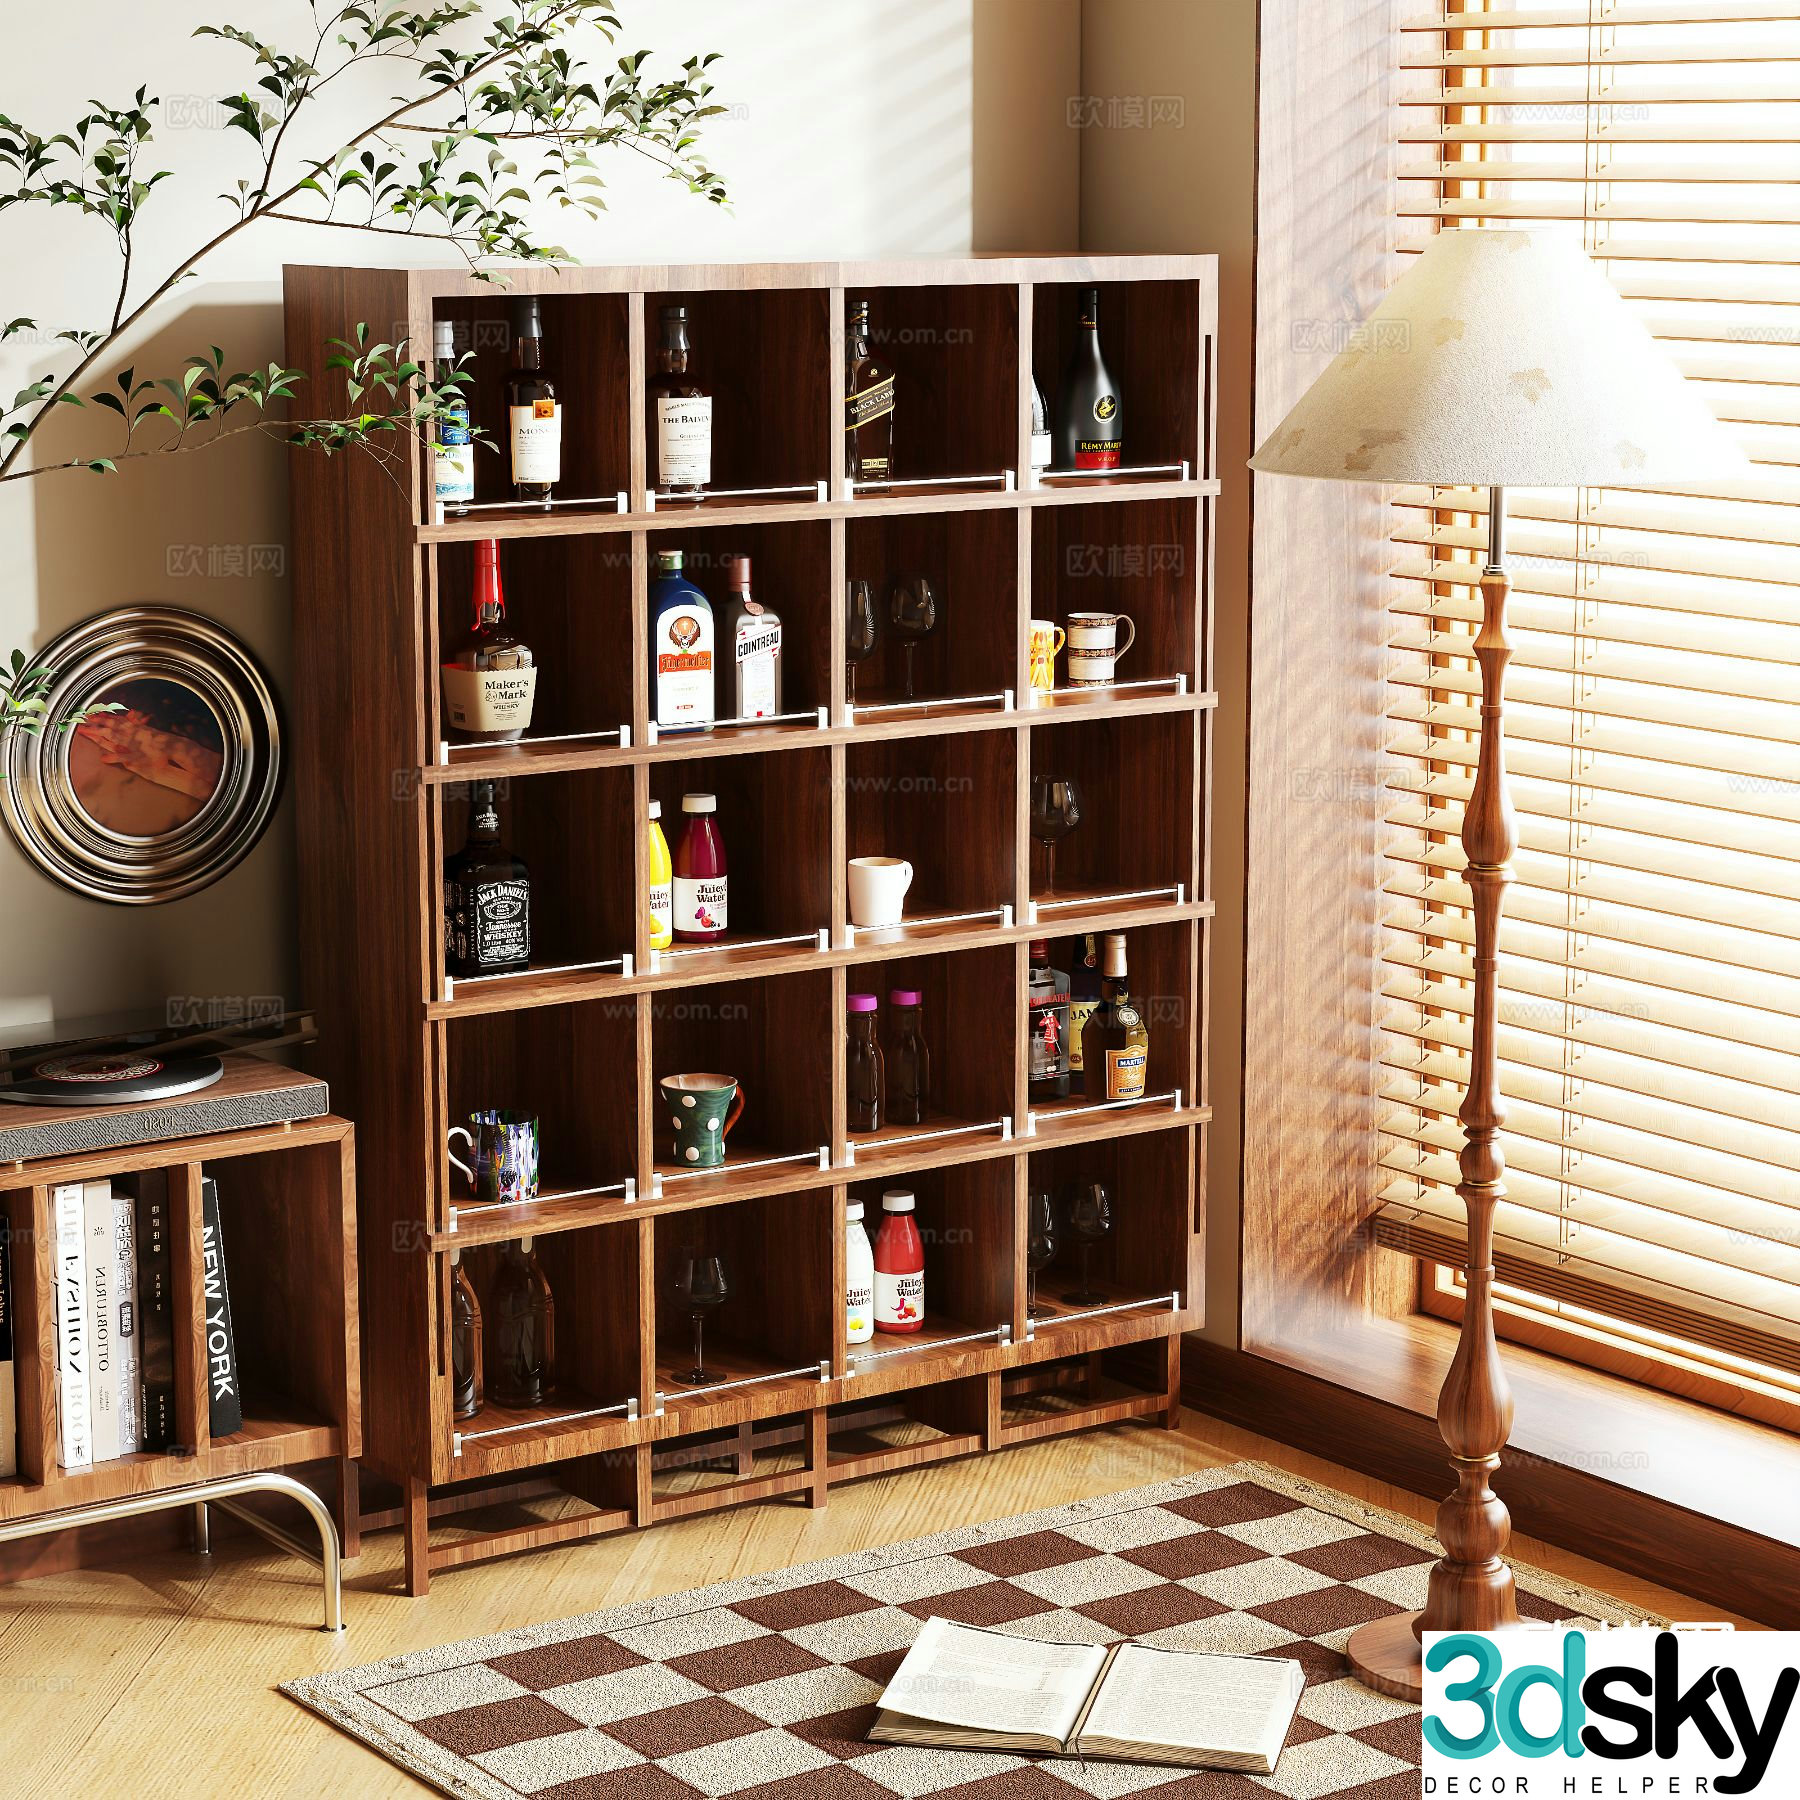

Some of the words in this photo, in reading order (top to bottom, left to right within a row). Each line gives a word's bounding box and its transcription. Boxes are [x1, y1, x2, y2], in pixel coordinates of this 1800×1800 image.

[850, 399, 875, 414] BLACK
[738, 630, 779, 657] COINTREAU
[485, 679, 529, 689] Maker's
[498, 690, 527, 700] Mark
[478, 889, 497, 905] JACK
[497, 885, 529, 901] DANIEL'S
[650, 890, 668, 900] uicy
[697, 894, 725, 903] Water
[485, 921, 521, 931] Tennessee
[484, 930, 522, 941] WHISKEY
[203, 1225, 223, 1300] NEW
[206, 1305, 234, 1402] YORK
